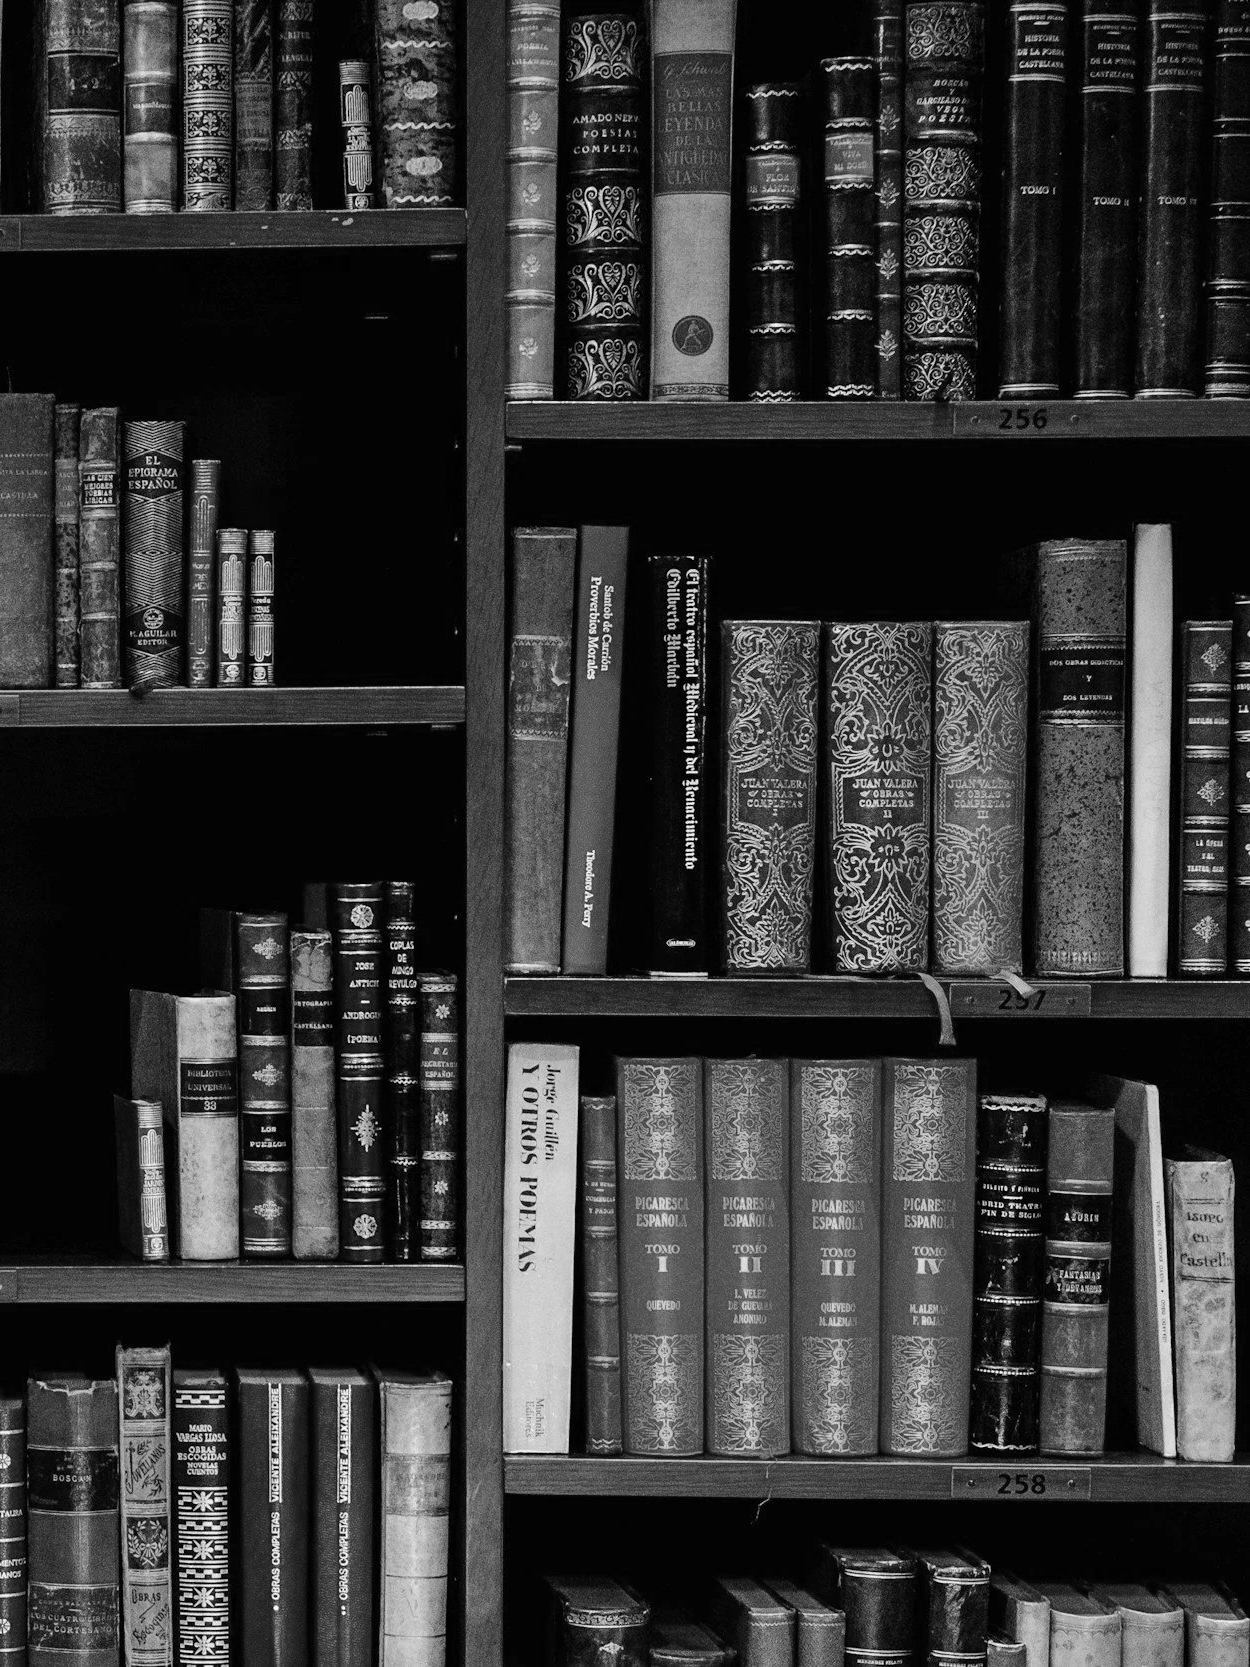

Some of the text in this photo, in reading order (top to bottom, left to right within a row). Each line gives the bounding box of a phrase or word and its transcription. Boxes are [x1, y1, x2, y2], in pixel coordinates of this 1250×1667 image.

[1024, 35, 1060, 43] HISTORIA
[1098, 42, 1131, 51] HISTORIA
[1165, 41, 1199, 50] HISTORIA
[668, 101, 721, 113] BELLAS
[583, 129, 638, 138] POESIAS
[998, 408, 1048, 430] 256
[146, 455, 161, 466] EL
[127, 468, 179, 478] EPIGRAMA
[127, 477, 178, 490] ESPAÑOL
[586, 575, 603, 681] Proverbios Morales
[600, 584, 615, 672] Santob de Carrión
[137, 639, 168, 647] EDITOR
[852, 777, 919, 789] JUAN VALERA
[873, 790, 905, 799] OBRAS
[746, 799, 804, 809] COMPLETAS
[858, 799, 915, 809] COMPLETAS
[581, 849, 596, 929] Theodore A. Perry
[389, 940, 415, 951] COPLAS
[397, 953, 408, 963] DE
[424, 1068, 456, 1078] ESPAÑOL
[203, 1100, 217, 1111] 33
[542, 1064, 562, 1161] Jorge Guillén
[249, 1140, 287, 1149] PUEBLOS
[517, 1063, 540, 1274] Y OTROS POEMAS
[635, 1196, 690, 1211] PICARESCA
[721, 1196, 776, 1211] PICARESCA
[811, 1198, 866, 1214] PICARESCA
[903, 1197, 957, 1213] PICARESCA
[636, 1213, 688, 1228] ESPAÑOLA
[723, 1212, 775, 1228] ESPAÑOLA
[644, 1244, 681, 1255] TOMO
[732, 1243, 768, 1255] TOMO
[820, 1247, 857, 1258] TOMO
[911, 1246, 948, 1257] TOMO
[820, 1259, 857, 1277] III
[915, 1257, 946, 1276] IV
[646, 1299, 681, 1312] QUEVEDO
[524, 1400, 535, 1439] Editores
[534, 1397, 546, 1438] Muchnik
[188, 1424, 213, 1433] MARIO
[188, 1446, 217, 1454] OBRAS
[271, 1387, 280, 1503] VICENTE ALEIXANDRE
[340, 1388, 349, 1503] VICENTE ALEIXANDRE
[176, 1452, 227, 1461] ESCOGIDAS
[187, 1468, 219, 1476] CUENTOS
[996, 1473, 1046, 1495] 258
[270, 1511, 280, 1601] OBRAS COMPLETAS
[339, 1511, 348, 1601] OBRAS COMPLETAS
